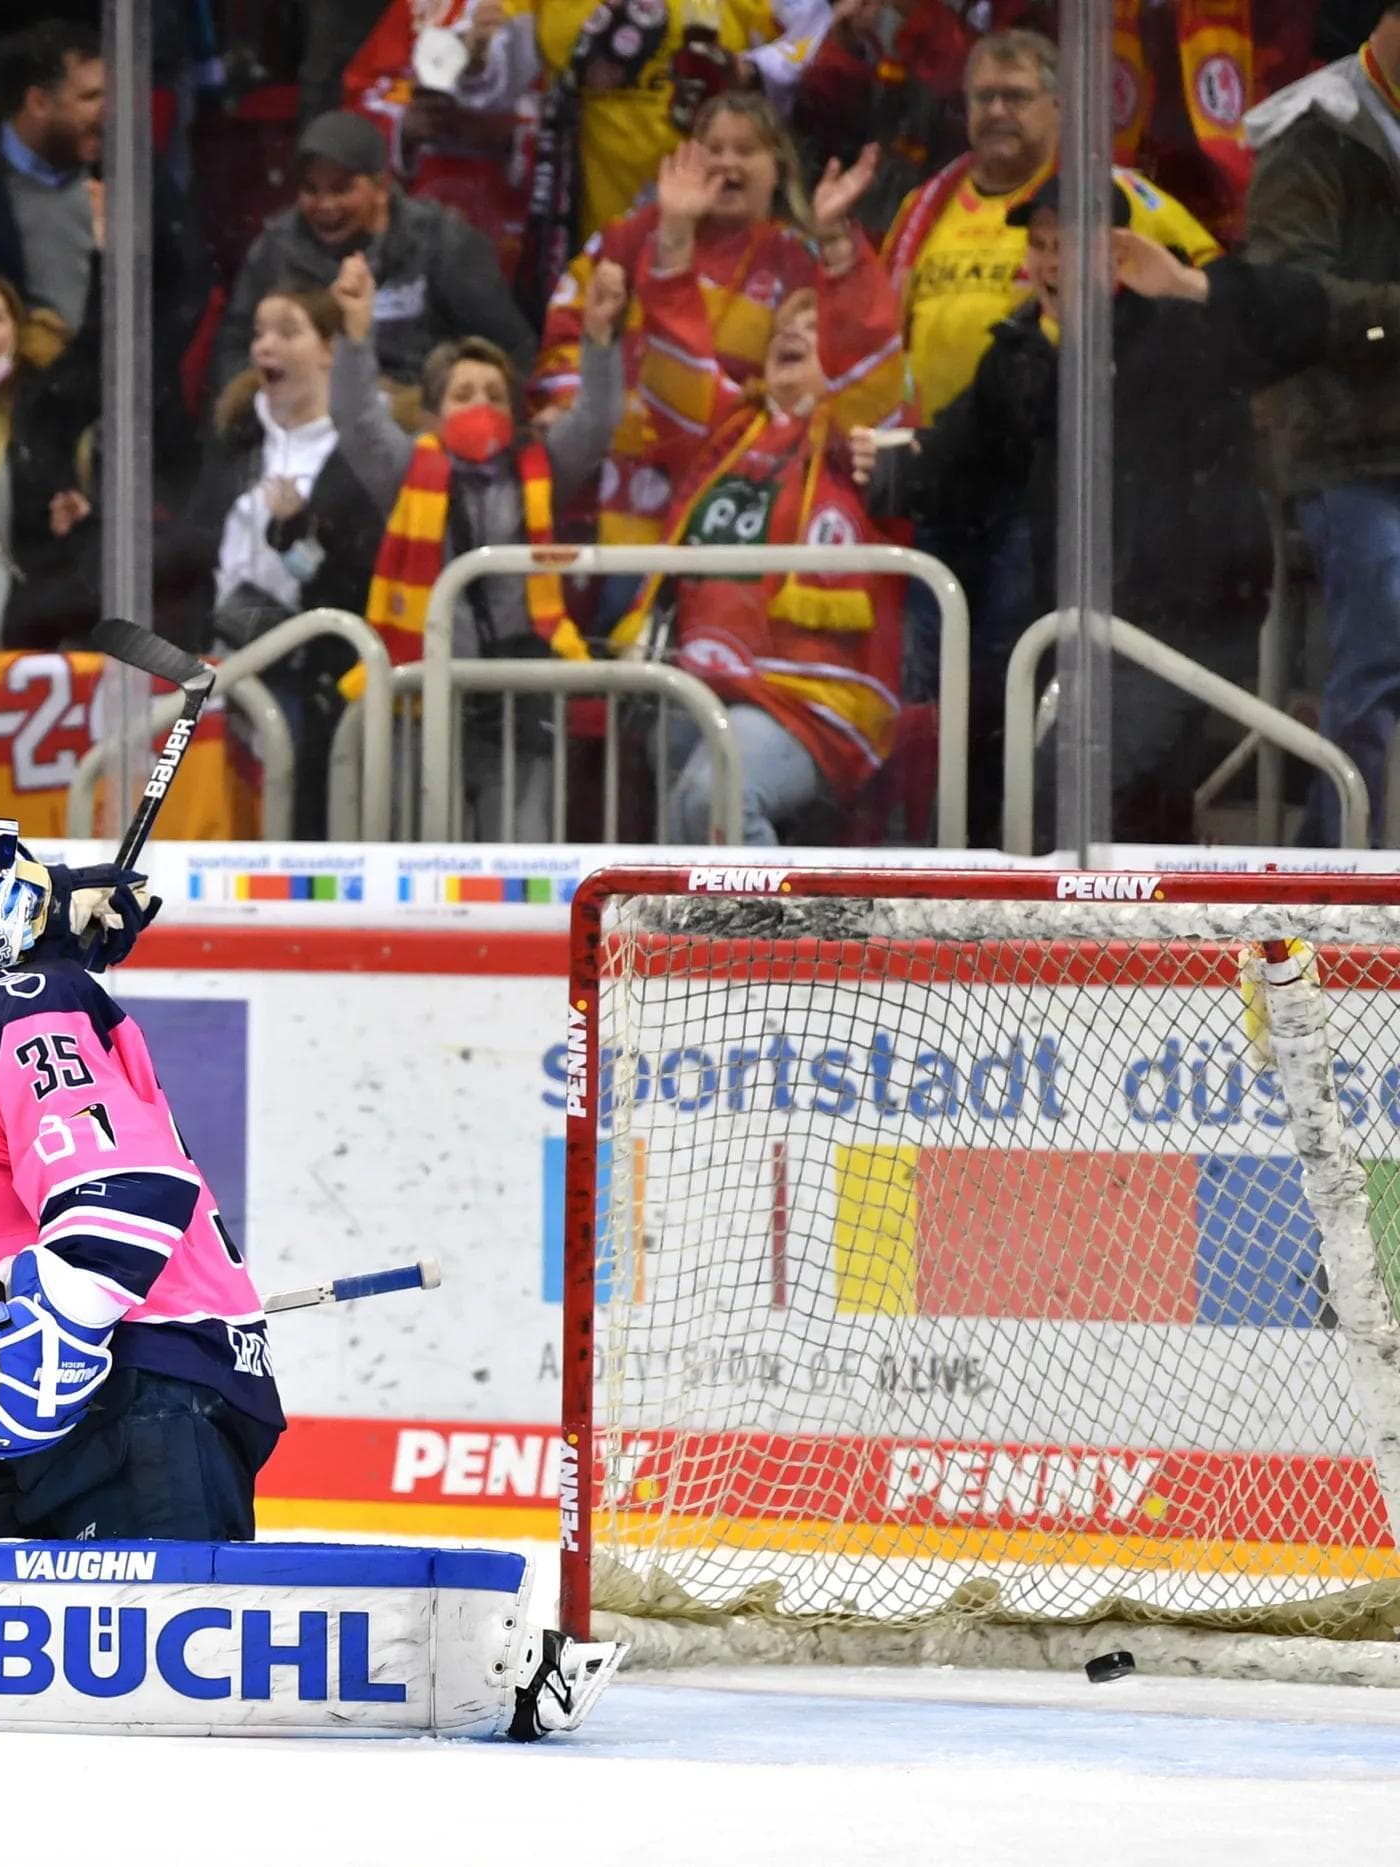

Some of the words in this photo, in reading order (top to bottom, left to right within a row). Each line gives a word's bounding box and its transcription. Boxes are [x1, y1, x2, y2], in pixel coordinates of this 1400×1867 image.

[145, 718, 195, 799] BAUER
[688, 868, 792, 892] PENNY.
[1057, 876, 1165, 900] PENNY.
[15, 1034, 95, 1101] 35
[566, 999, 588, 1118] PENNY.
[559, 1433, 580, 1553] PENNY.
[885, 1447, 1168, 1520] PENNY.
[14, 1550, 157, 1580] VAUGHN
